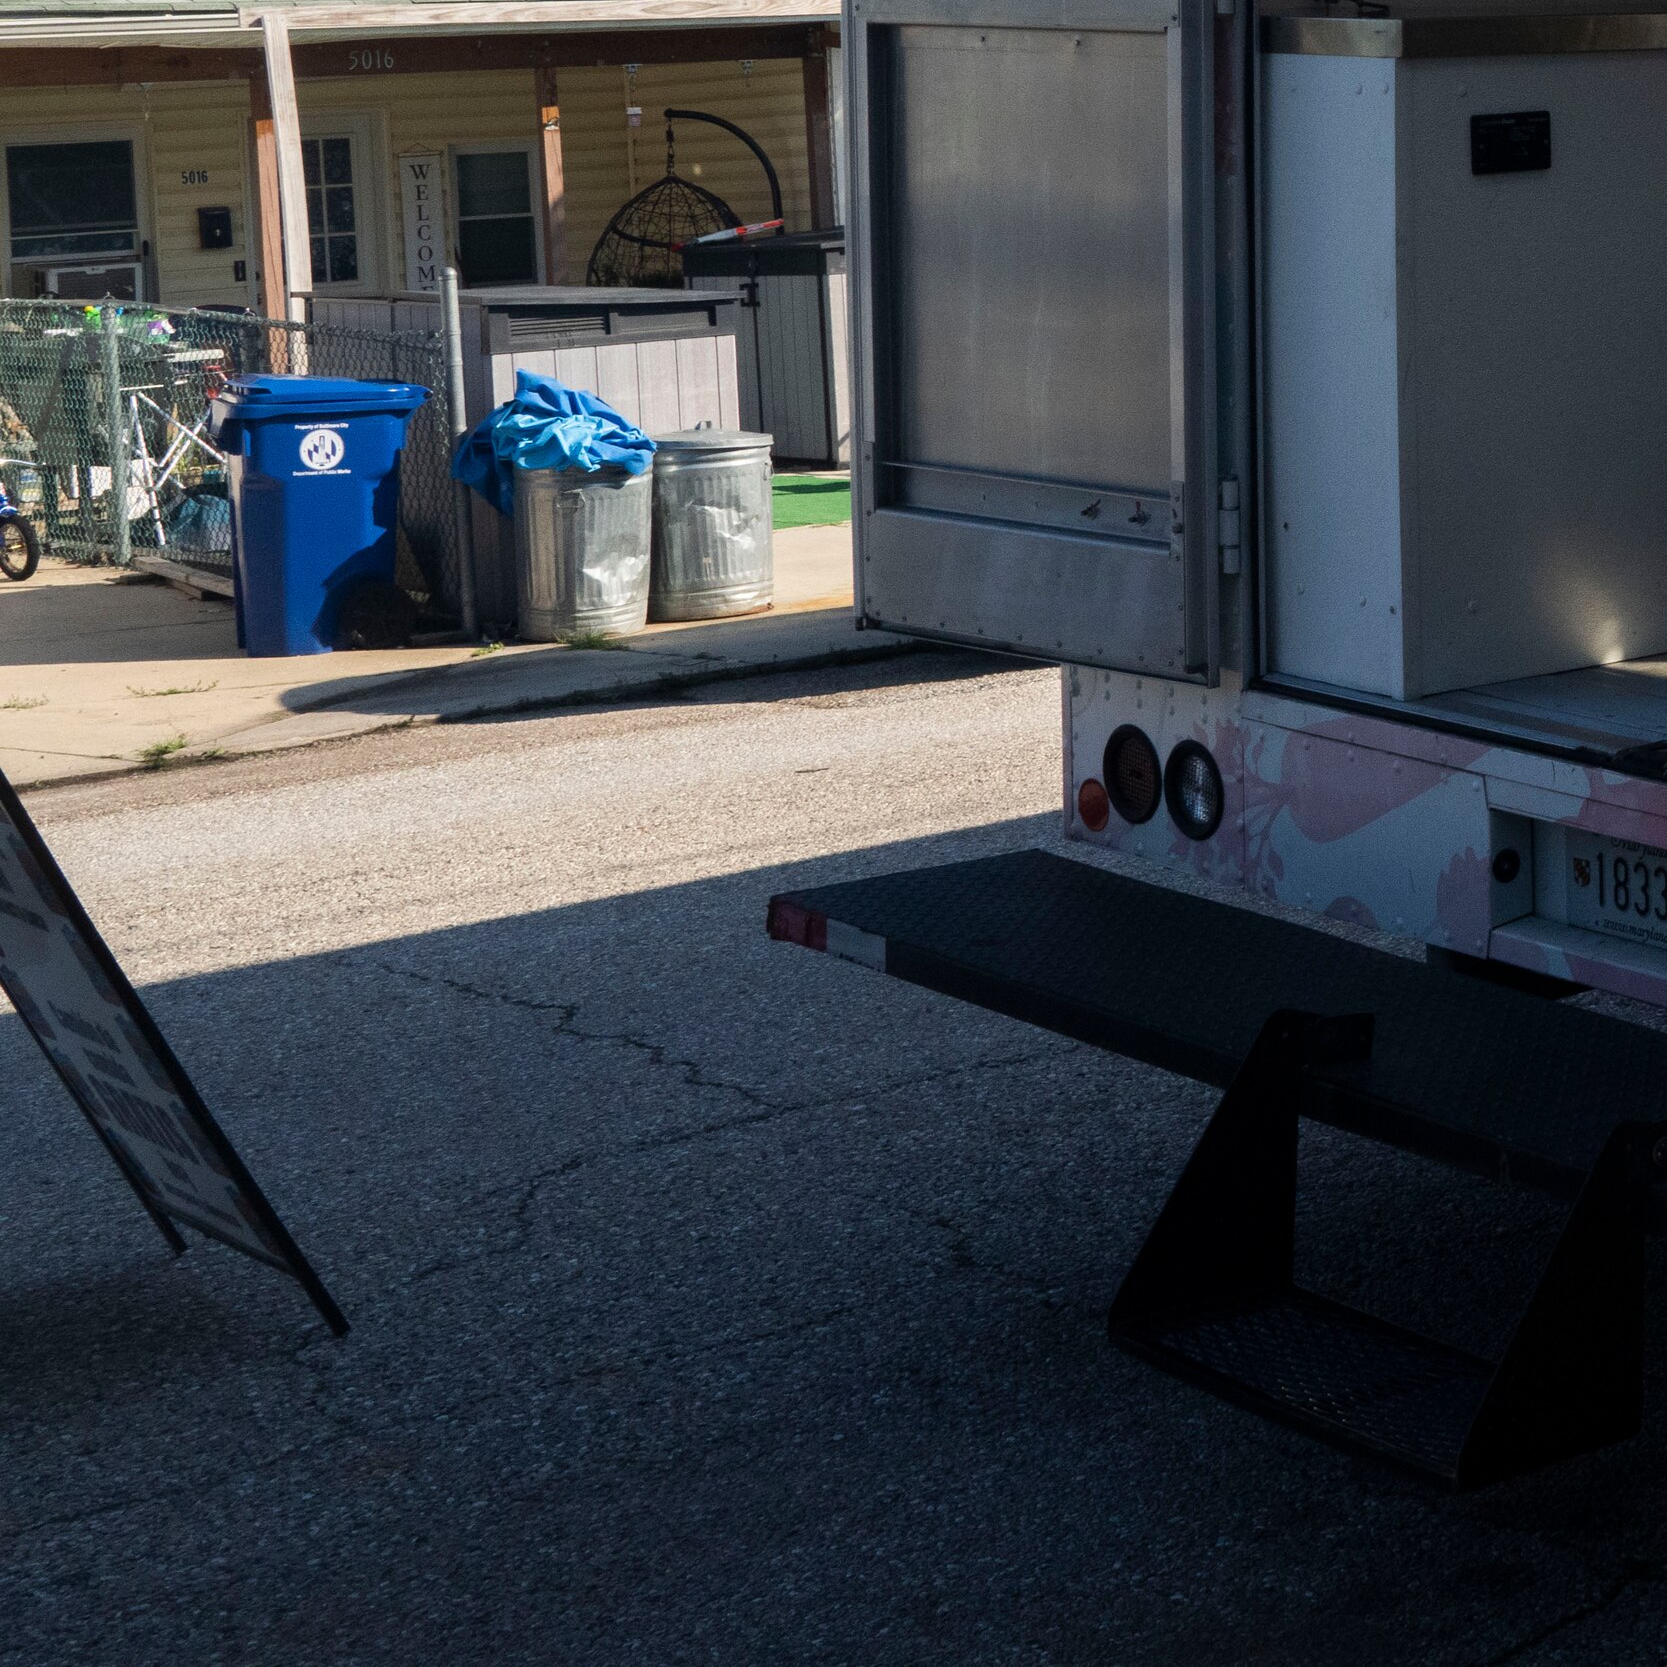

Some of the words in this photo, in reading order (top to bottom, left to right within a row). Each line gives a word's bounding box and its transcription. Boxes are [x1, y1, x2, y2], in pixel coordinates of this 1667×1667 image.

[349, 48, 395, 71] 5016
[181, 169, 209, 185] 5016
[408, 162, 441, 291] WELCOM
